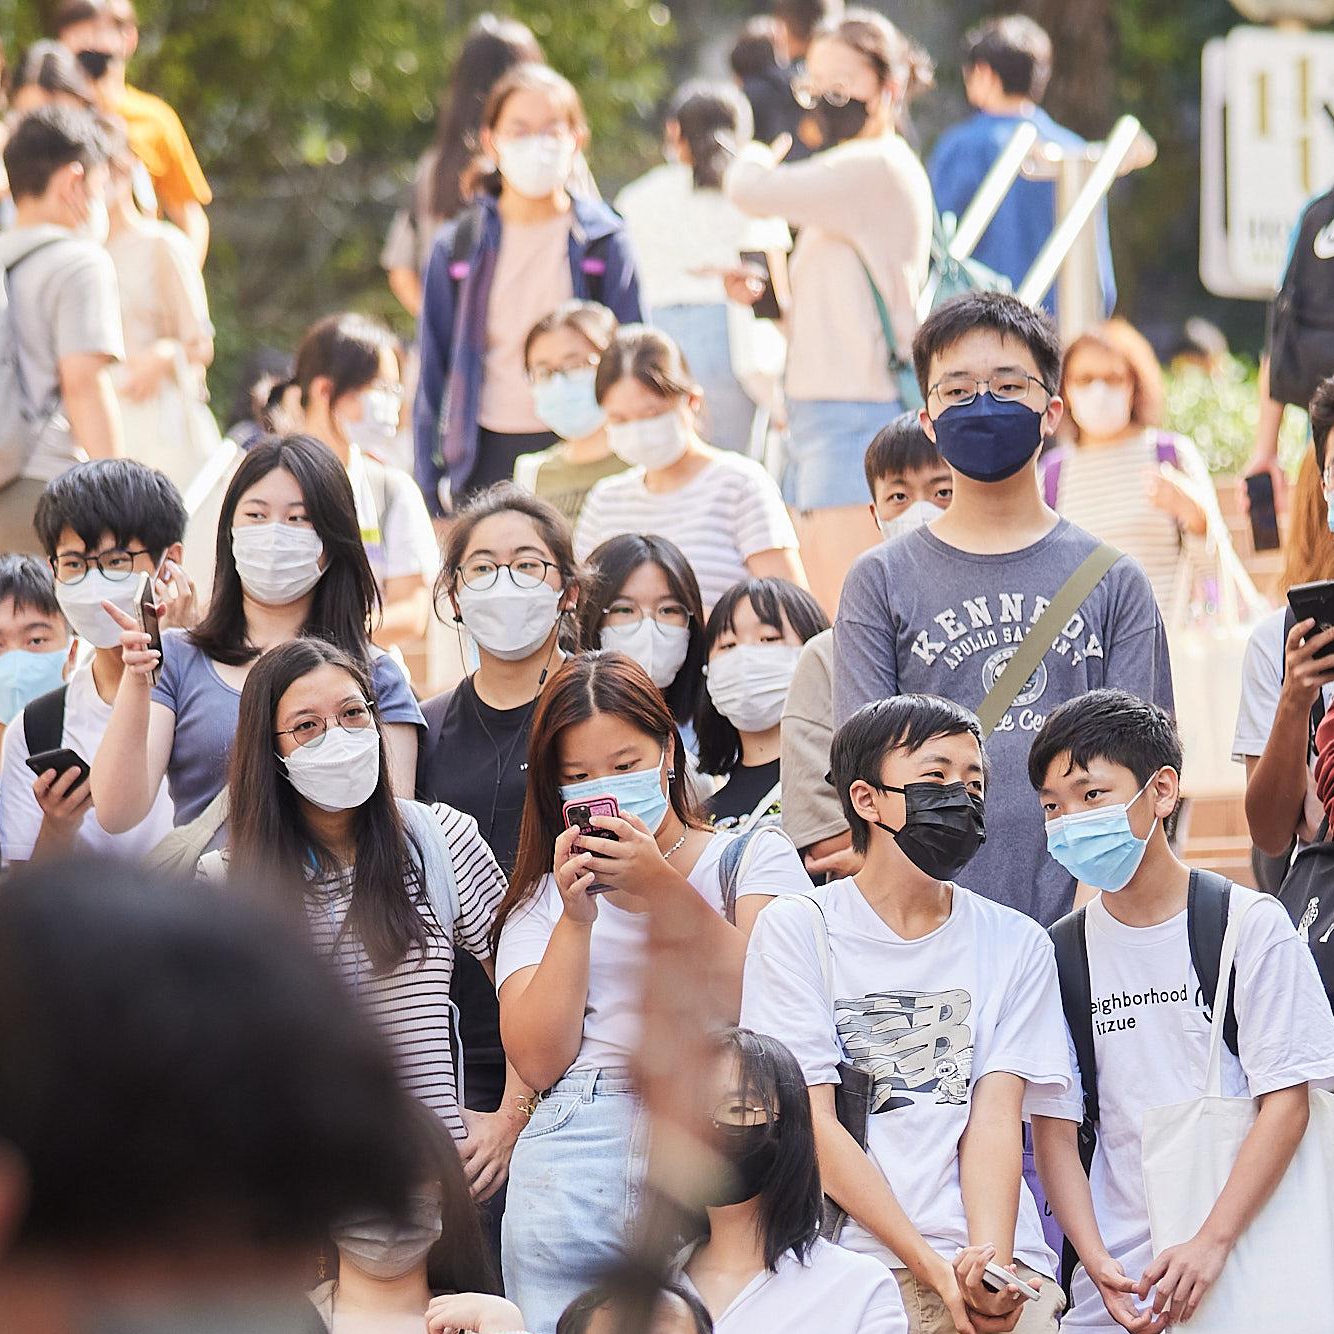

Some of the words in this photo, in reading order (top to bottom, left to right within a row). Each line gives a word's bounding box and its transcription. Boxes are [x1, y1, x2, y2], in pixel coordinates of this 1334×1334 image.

[943, 629, 998, 671] APOLLO
[1091, 983, 1188, 1015] eighborhood
[1095, 1016, 1136, 1036] izzue
